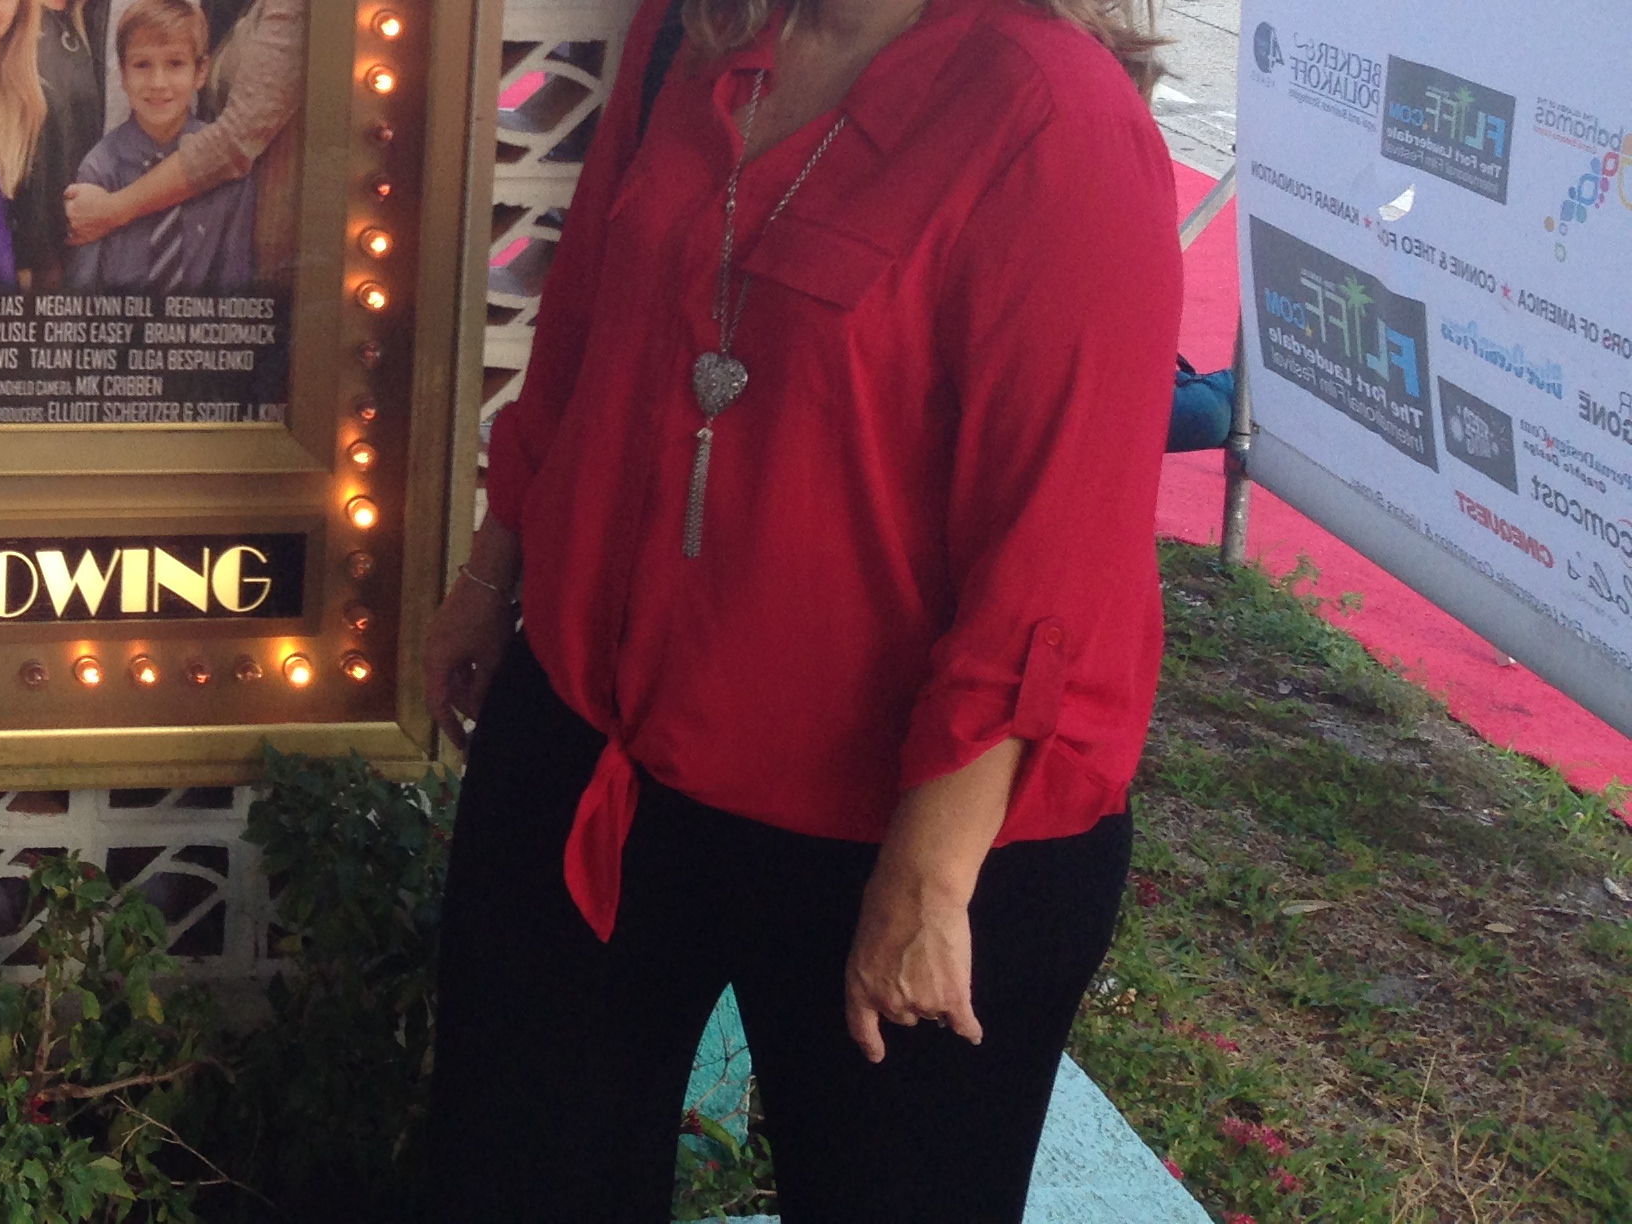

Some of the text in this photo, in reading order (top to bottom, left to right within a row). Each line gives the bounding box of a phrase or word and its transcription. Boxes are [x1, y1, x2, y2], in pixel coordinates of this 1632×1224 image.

[35, 295, 83, 317] MEGAN
[87, 295, 122, 317] LYNN
[125, 295, 154, 317] GILL
[165, 296, 214, 318] REGINA
[218, 297, 275, 319] HODGES
[44, 322, 87, 343] CHRIS
[90, 322, 134, 344] EASEY
[145, 322, 187, 344] BRIAN
[189, 323, 276, 345] MCCORMACK
[30, 347, 73, 369] TALAN
[76, 348, 118, 370] LEWIS
[128, 349, 165, 371] OLGA
[168, 349, 255, 371] BESPALENKO
[75, 375, 100, 396] MIK
[103, 376, 164, 396] CRIBBEN
[48, 401, 100, 423] ELLIOTT
[103, 401, 181, 423] SCHERTZER
[197, 401, 240, 423] SCOTT
